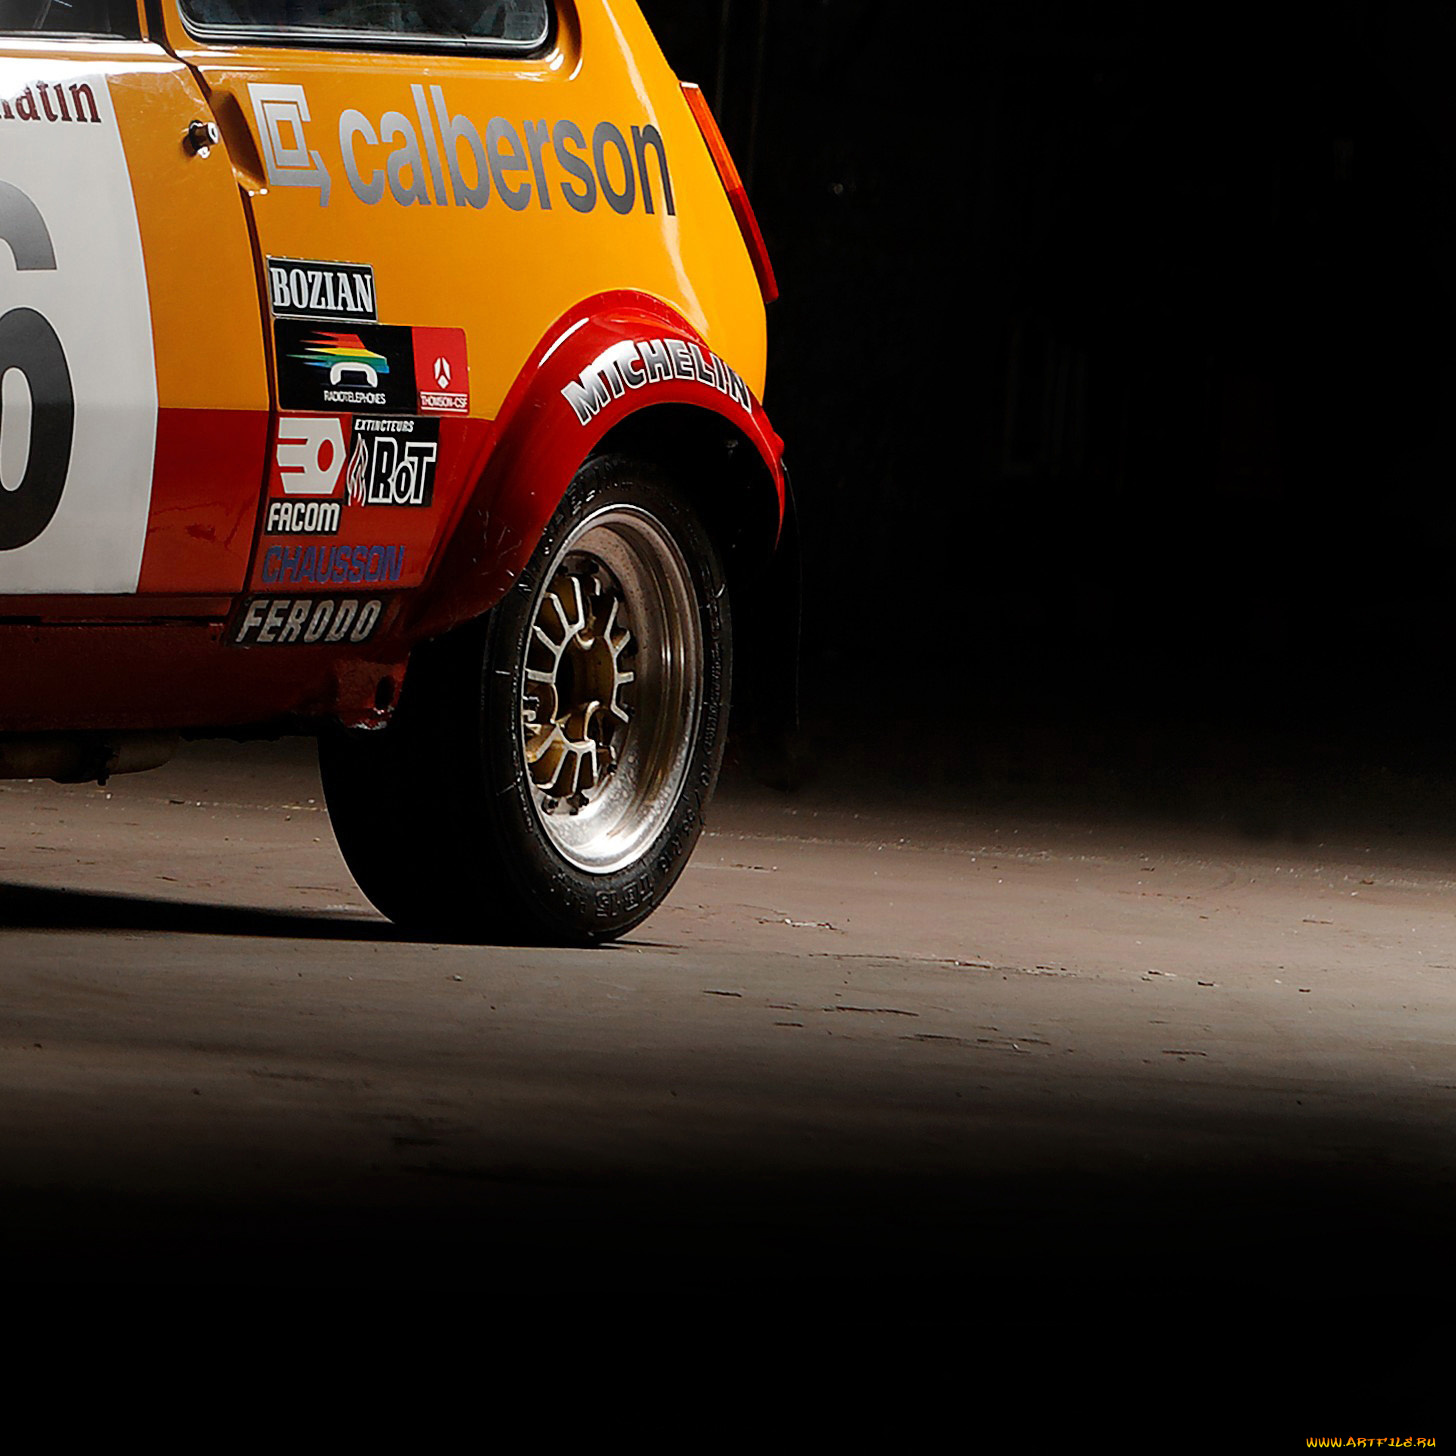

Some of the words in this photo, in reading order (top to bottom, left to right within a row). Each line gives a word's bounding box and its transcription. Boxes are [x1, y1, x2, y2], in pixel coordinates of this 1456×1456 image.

[338, 83, 676, 216] calberson
[272, 267, 374, 313] BOZIAN
[324, 390, 387, 404] RADIOTELEPHONES
[421, 395, 468, 409] THOMSON-CSF
[560, 339, 754, 426] MICHELIN
[354, 418, 415, 433] EXTINCTEURS
[267, 502, 340, 533] FACOM
[261, 545, 405, 584] CHAUSSON
[235, 599, 382, 644] FERODO
